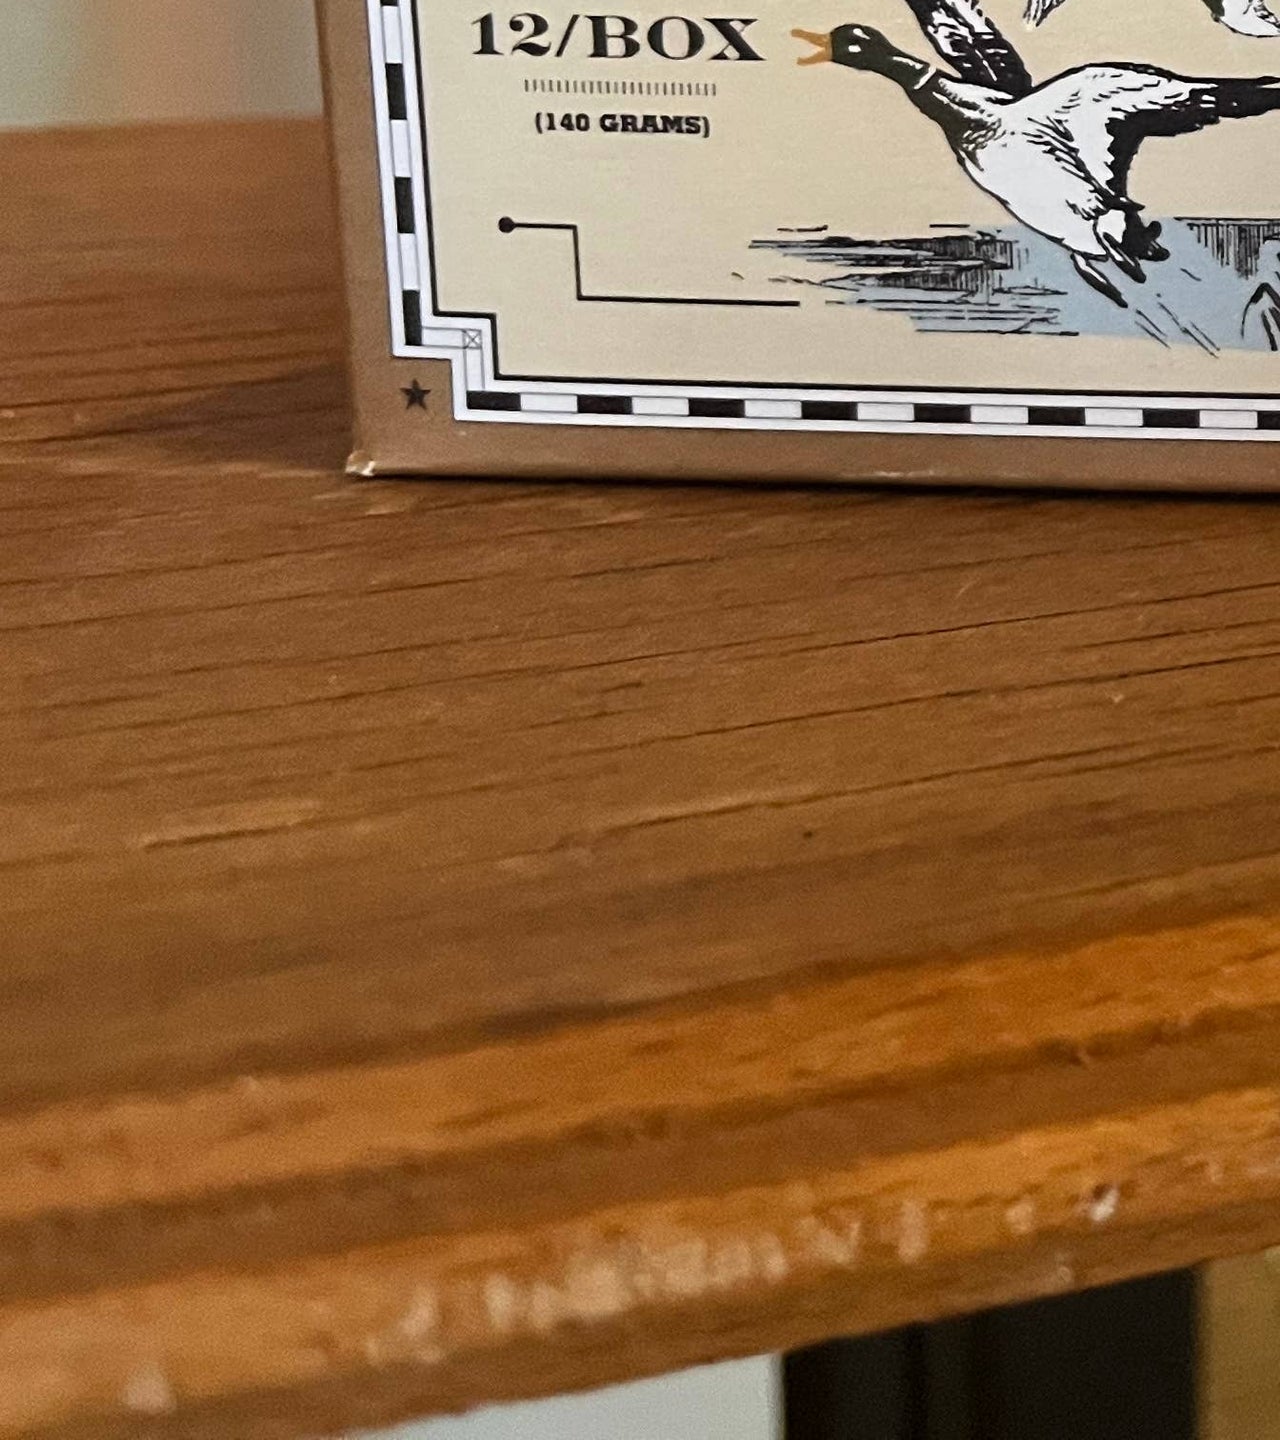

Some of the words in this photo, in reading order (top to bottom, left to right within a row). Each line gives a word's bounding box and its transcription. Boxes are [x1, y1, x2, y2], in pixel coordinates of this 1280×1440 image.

[470, 12, 767, 61] 12/BOX
[535, 112, 590, 134] (140
[599, 114, 710, 138] GRAMS)
